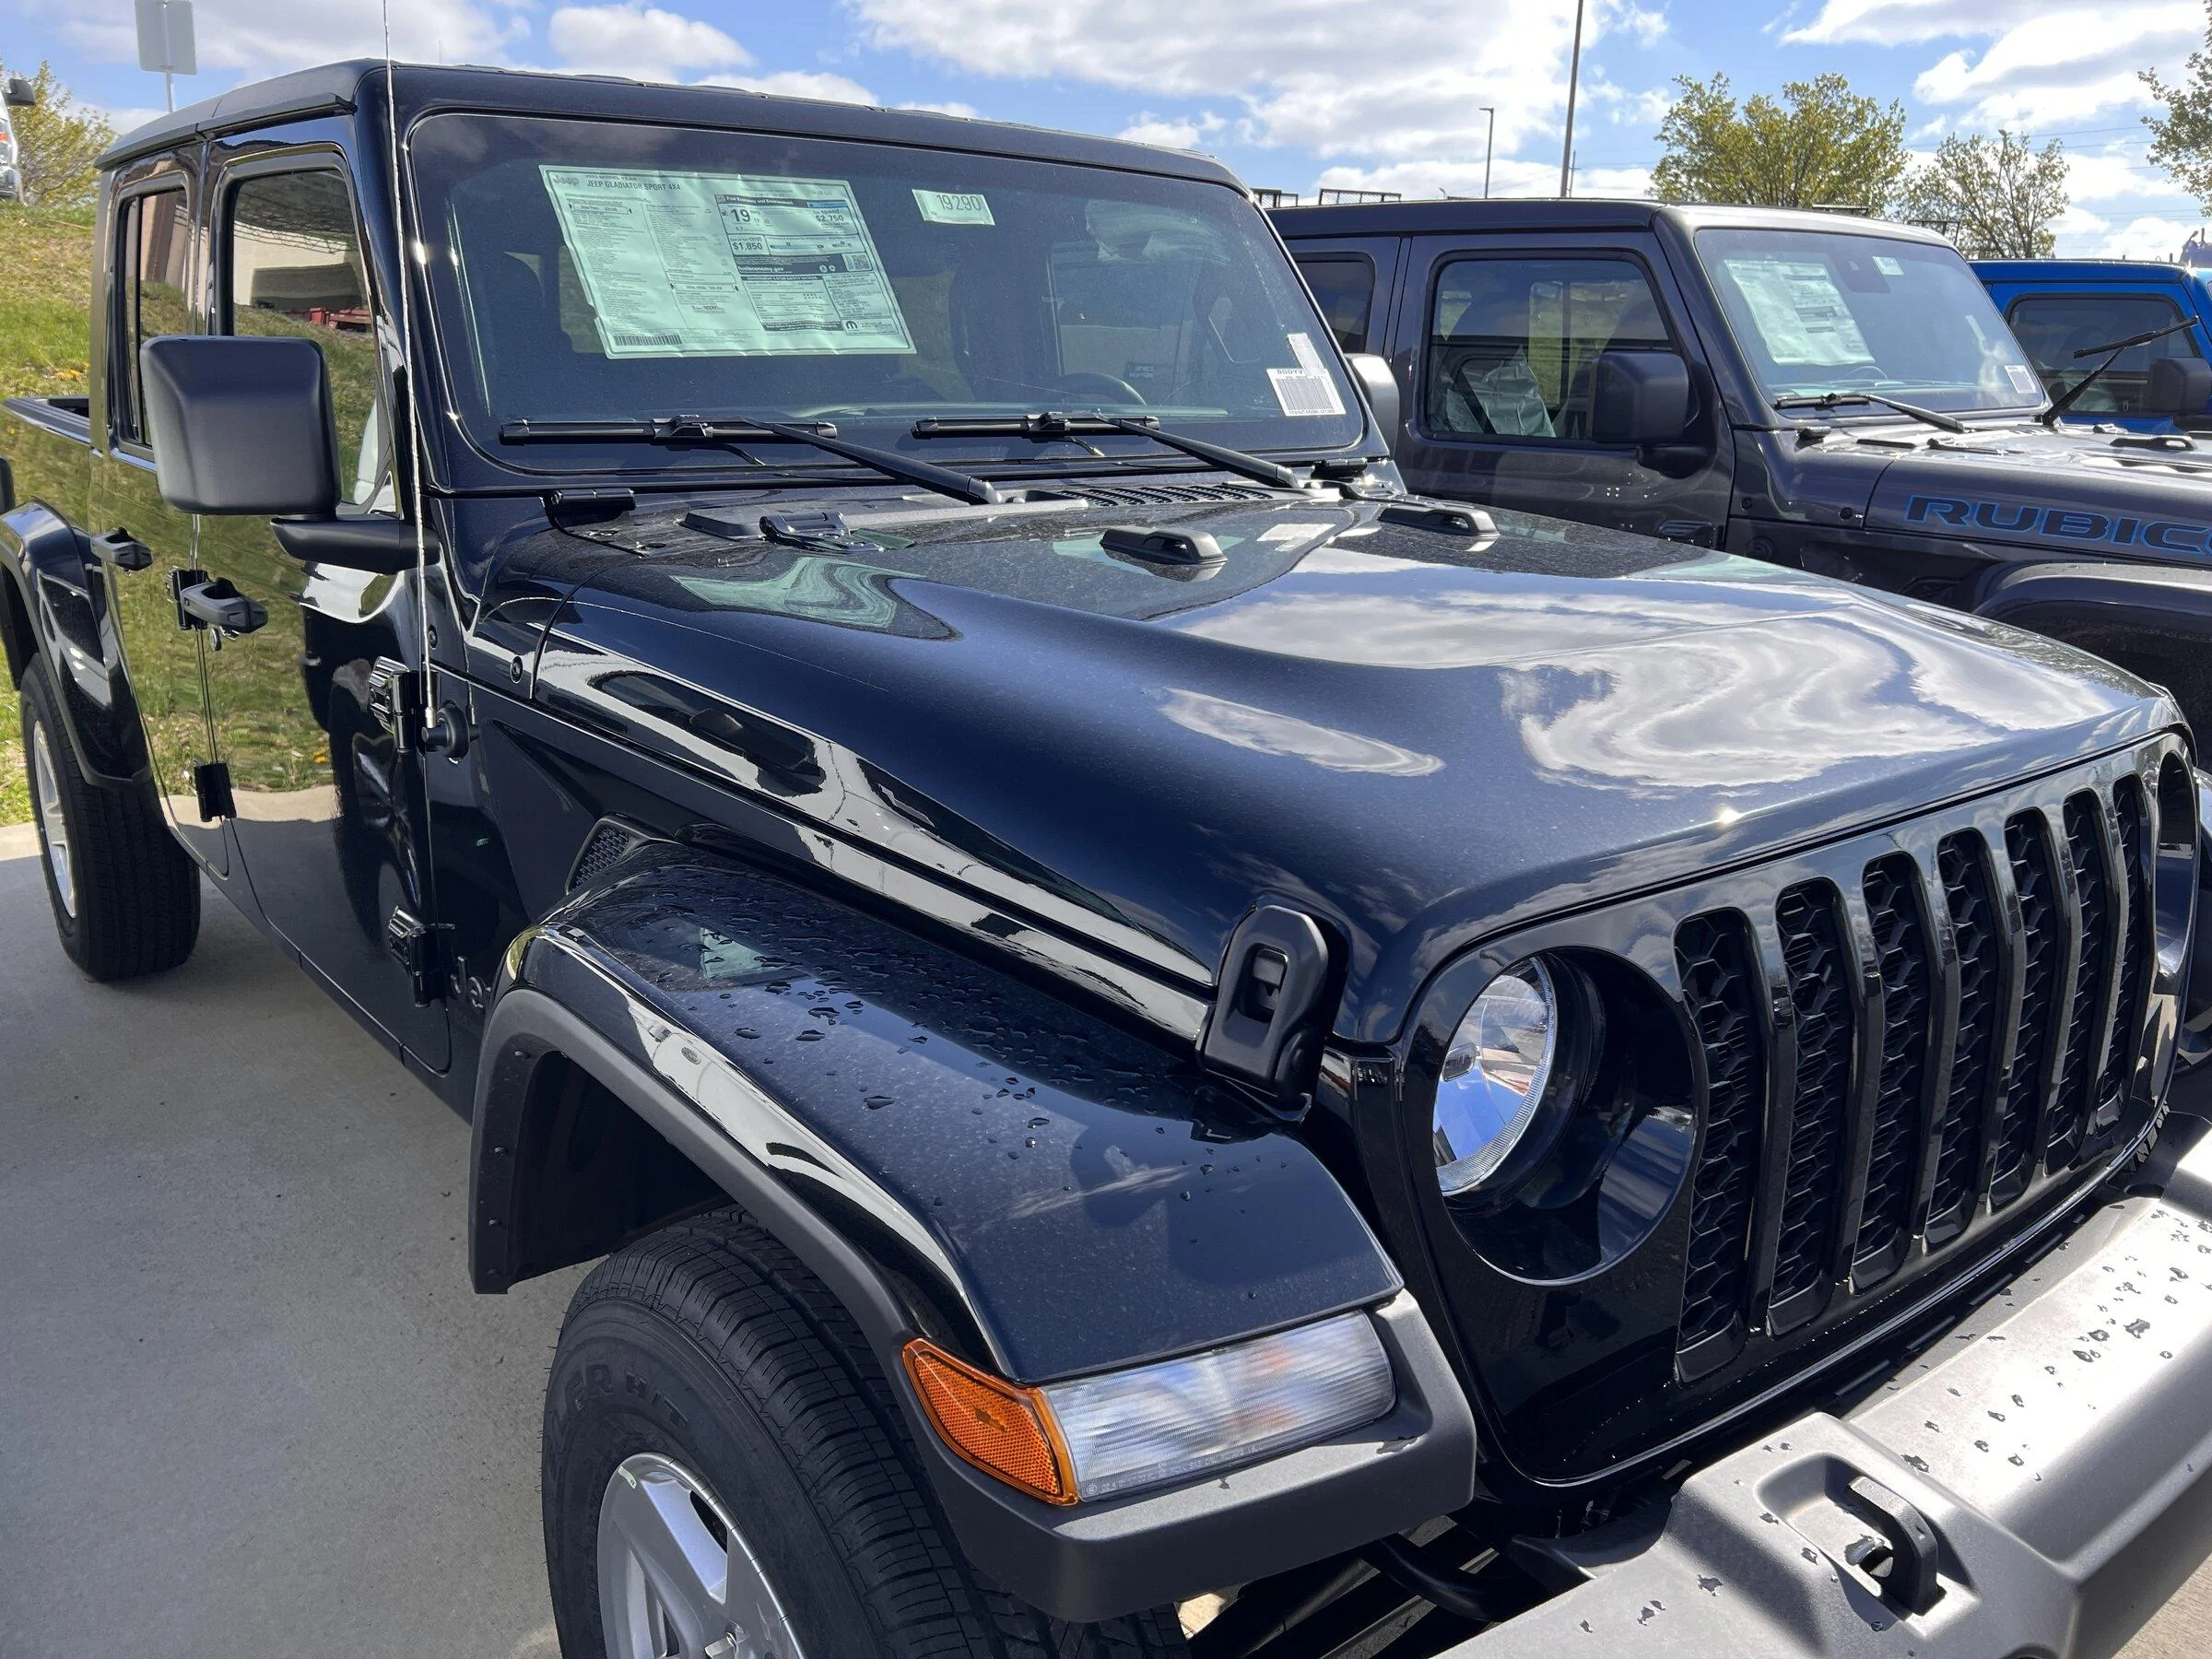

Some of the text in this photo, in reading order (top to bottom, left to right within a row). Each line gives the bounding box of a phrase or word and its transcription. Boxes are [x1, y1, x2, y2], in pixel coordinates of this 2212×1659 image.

[587, 180, 604, 188] JEEP
[605, 181, 643, 190] GLADIATOR
[644, 182, 666, 191] SPORT
[935, 194, 982, 211] 19290
[731, 208, 750, 222] 19
[732, 242, 763, 252] $1,850
[1904, 495, 2212, 557] RUBIC
